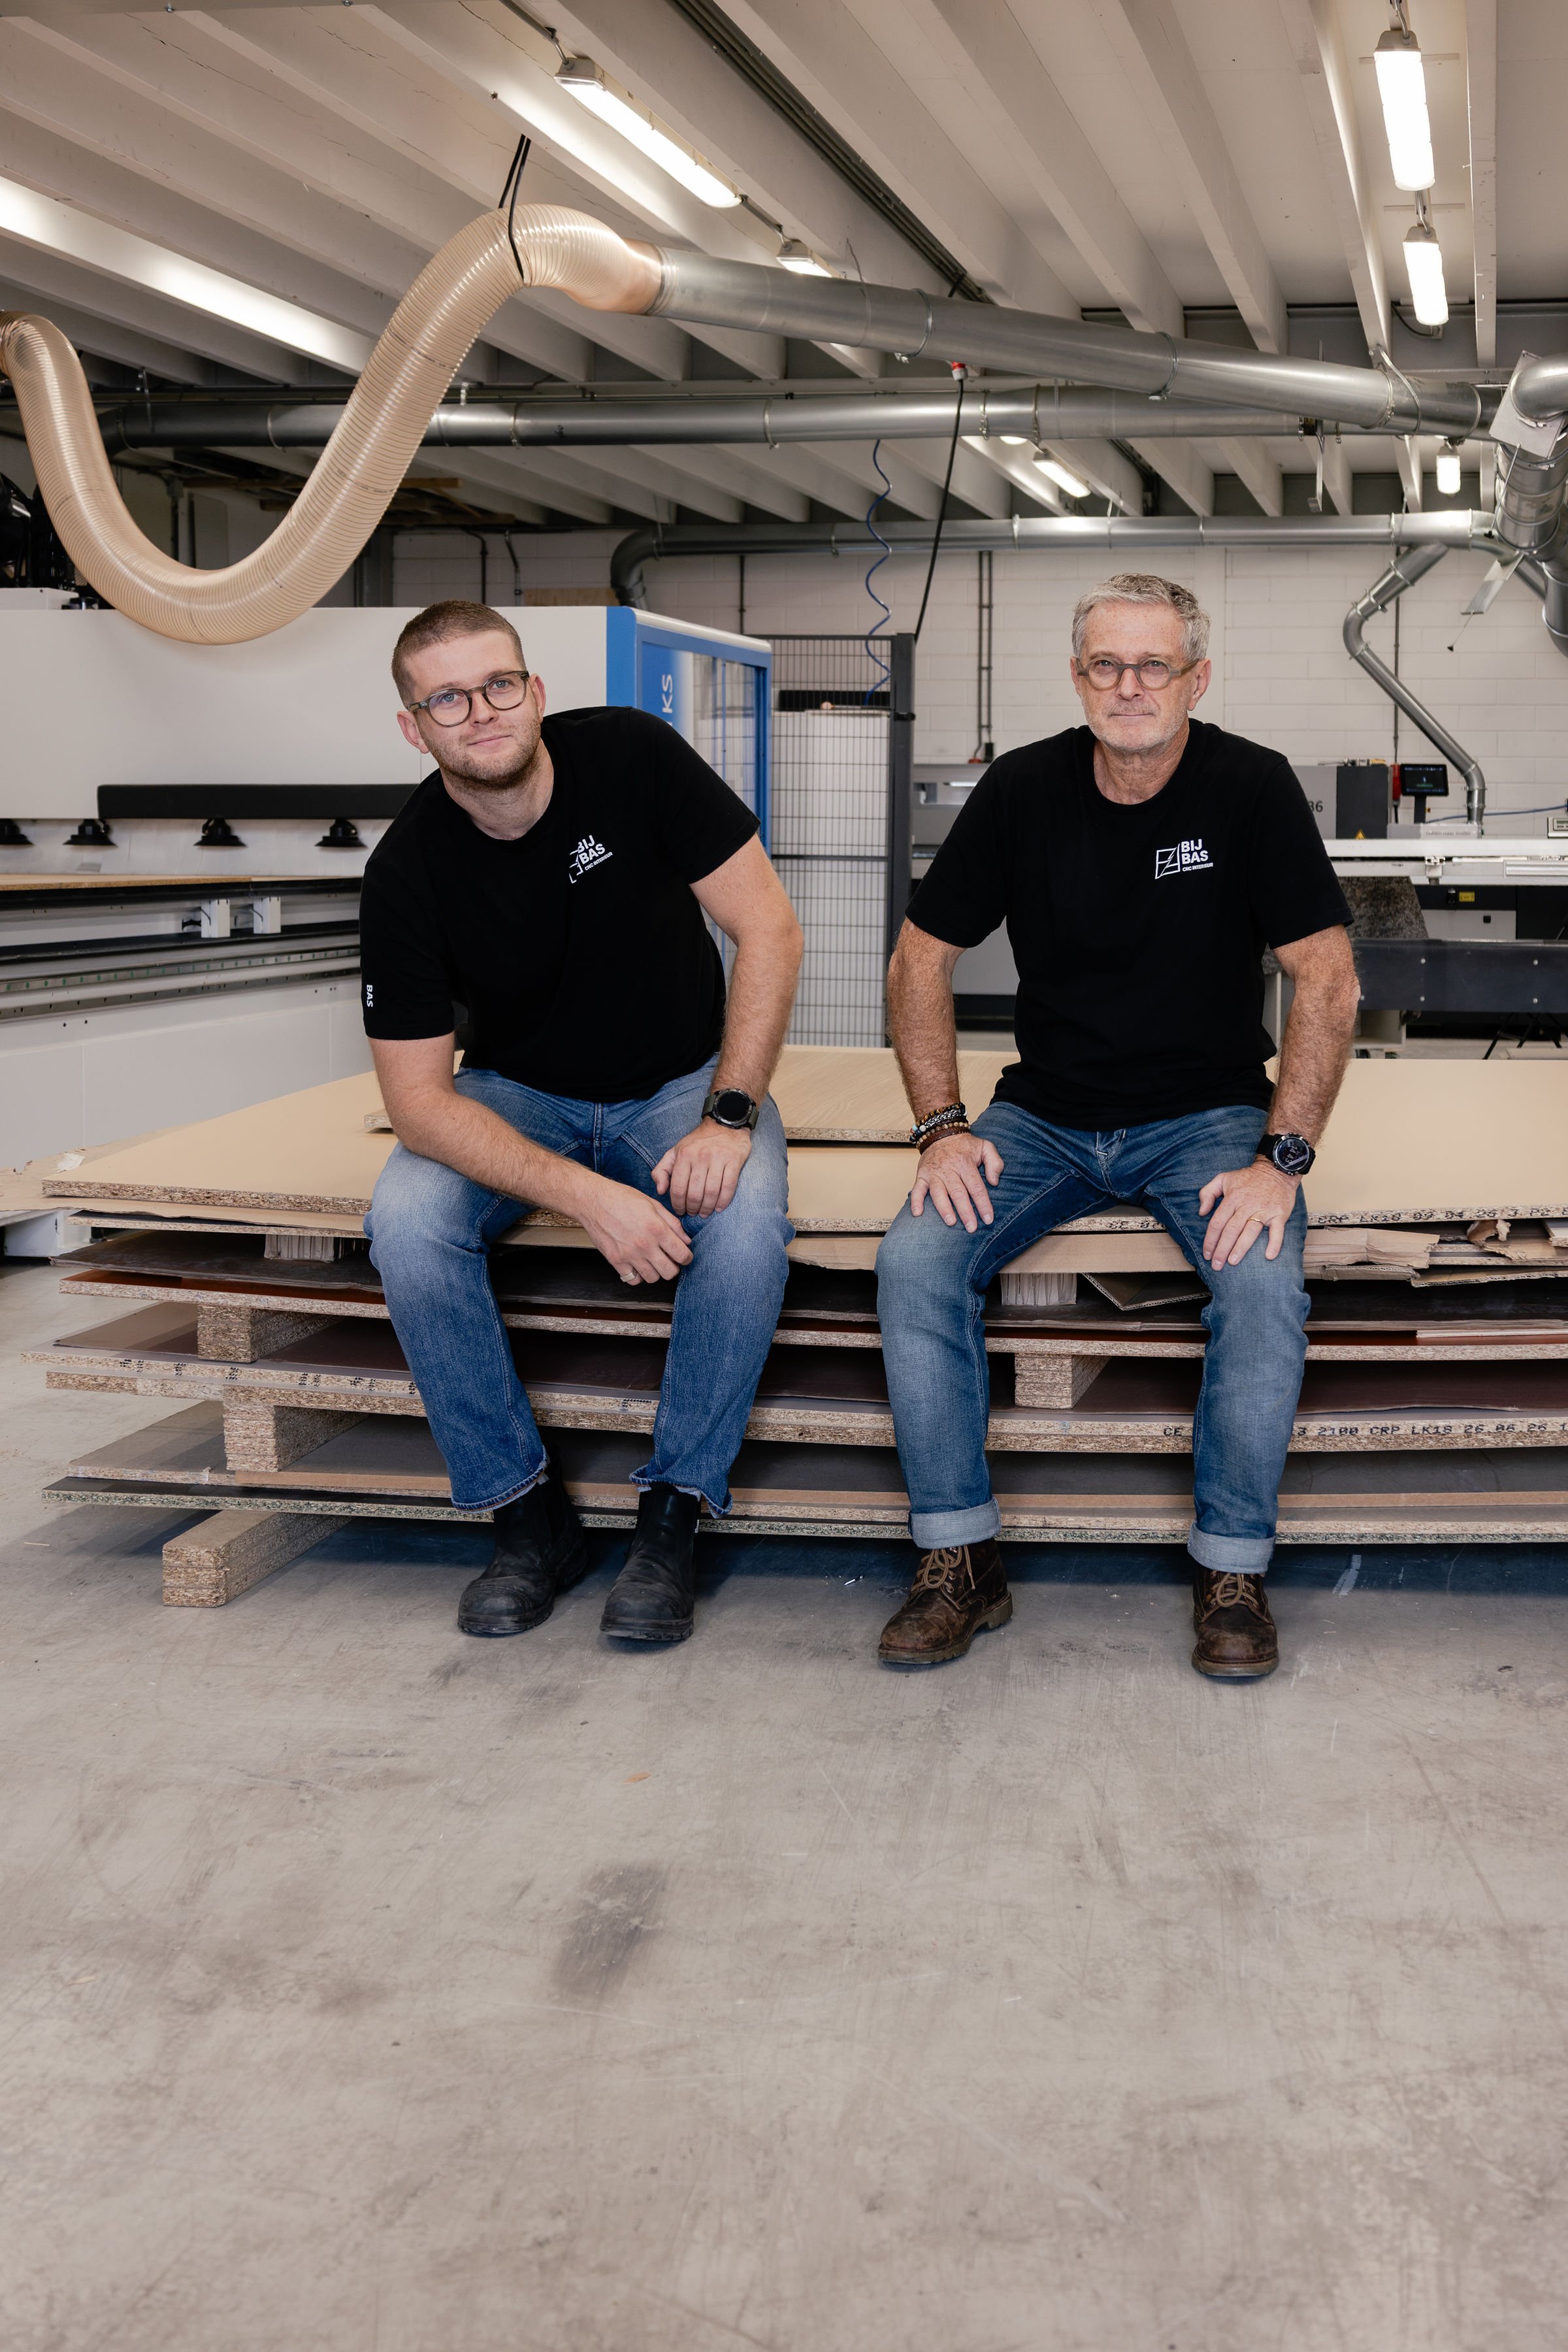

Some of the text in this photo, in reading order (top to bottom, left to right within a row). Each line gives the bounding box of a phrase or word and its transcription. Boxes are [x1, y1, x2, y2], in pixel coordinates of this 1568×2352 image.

[578, 834, 595, 854] BIJ
[1181, 838, 1202, 853] BIJ
[578, 843, 606, 864] BAS
[584, 851, 613, 871] CNC INTERIEUR
[1181, 850, 1209, 864] BAS
[1192, 862, 1214, 871] INTERIEUR
[1164, 1428, 1183, 1437] CE
[1369, 1426, 1400, 1435] CRP
[1411, 1424, 1453, 1435] LK18
